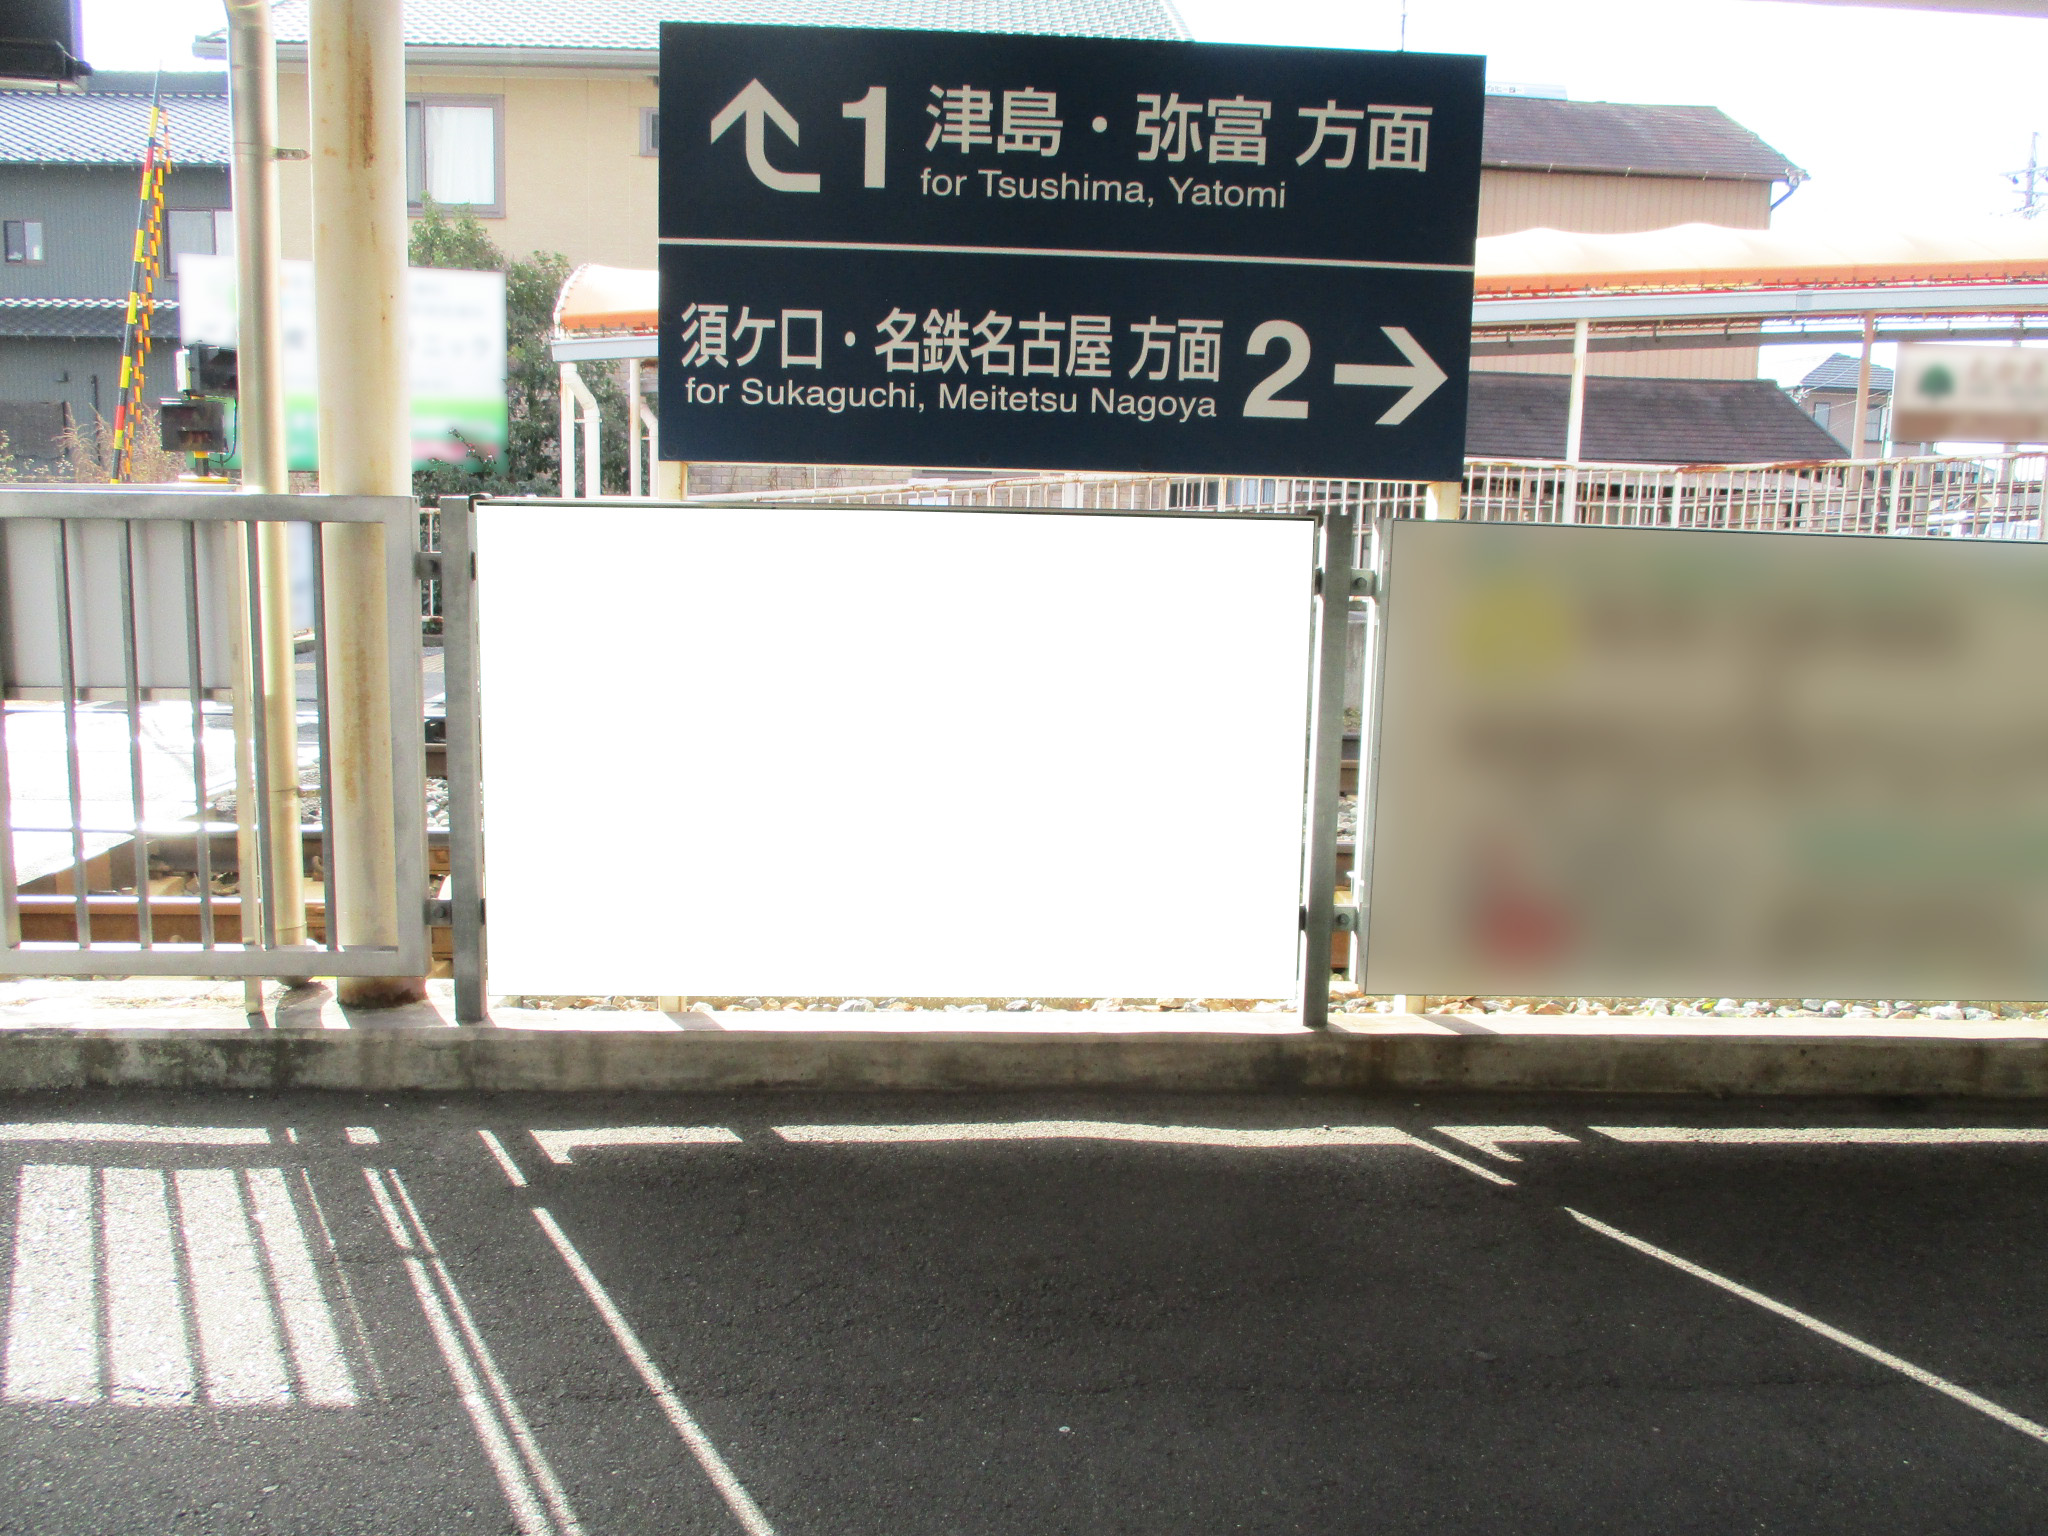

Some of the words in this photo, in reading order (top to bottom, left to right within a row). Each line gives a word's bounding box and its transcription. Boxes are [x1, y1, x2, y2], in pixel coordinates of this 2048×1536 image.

[842, 86, 887, 189] 1
[924, 84, 1272, 167] 津島・弥富
[1295, 99, 1433, 172] 方面
[920, 167, 967, 196] for
[977, 169, 1154, 208] Tsushima,
[1168, 176, 1286, 208] Yatomi
[684, 376, 730, 404] for
[740, 377, 926, 414] Sukaguchi,
[938, 383, 1078, 413] Meitetsu
[1091, 387, 1217, 422] Nagoya
[1128, 315, 1224, 383] 方面
[1242, 319, 1311, 419] 2
